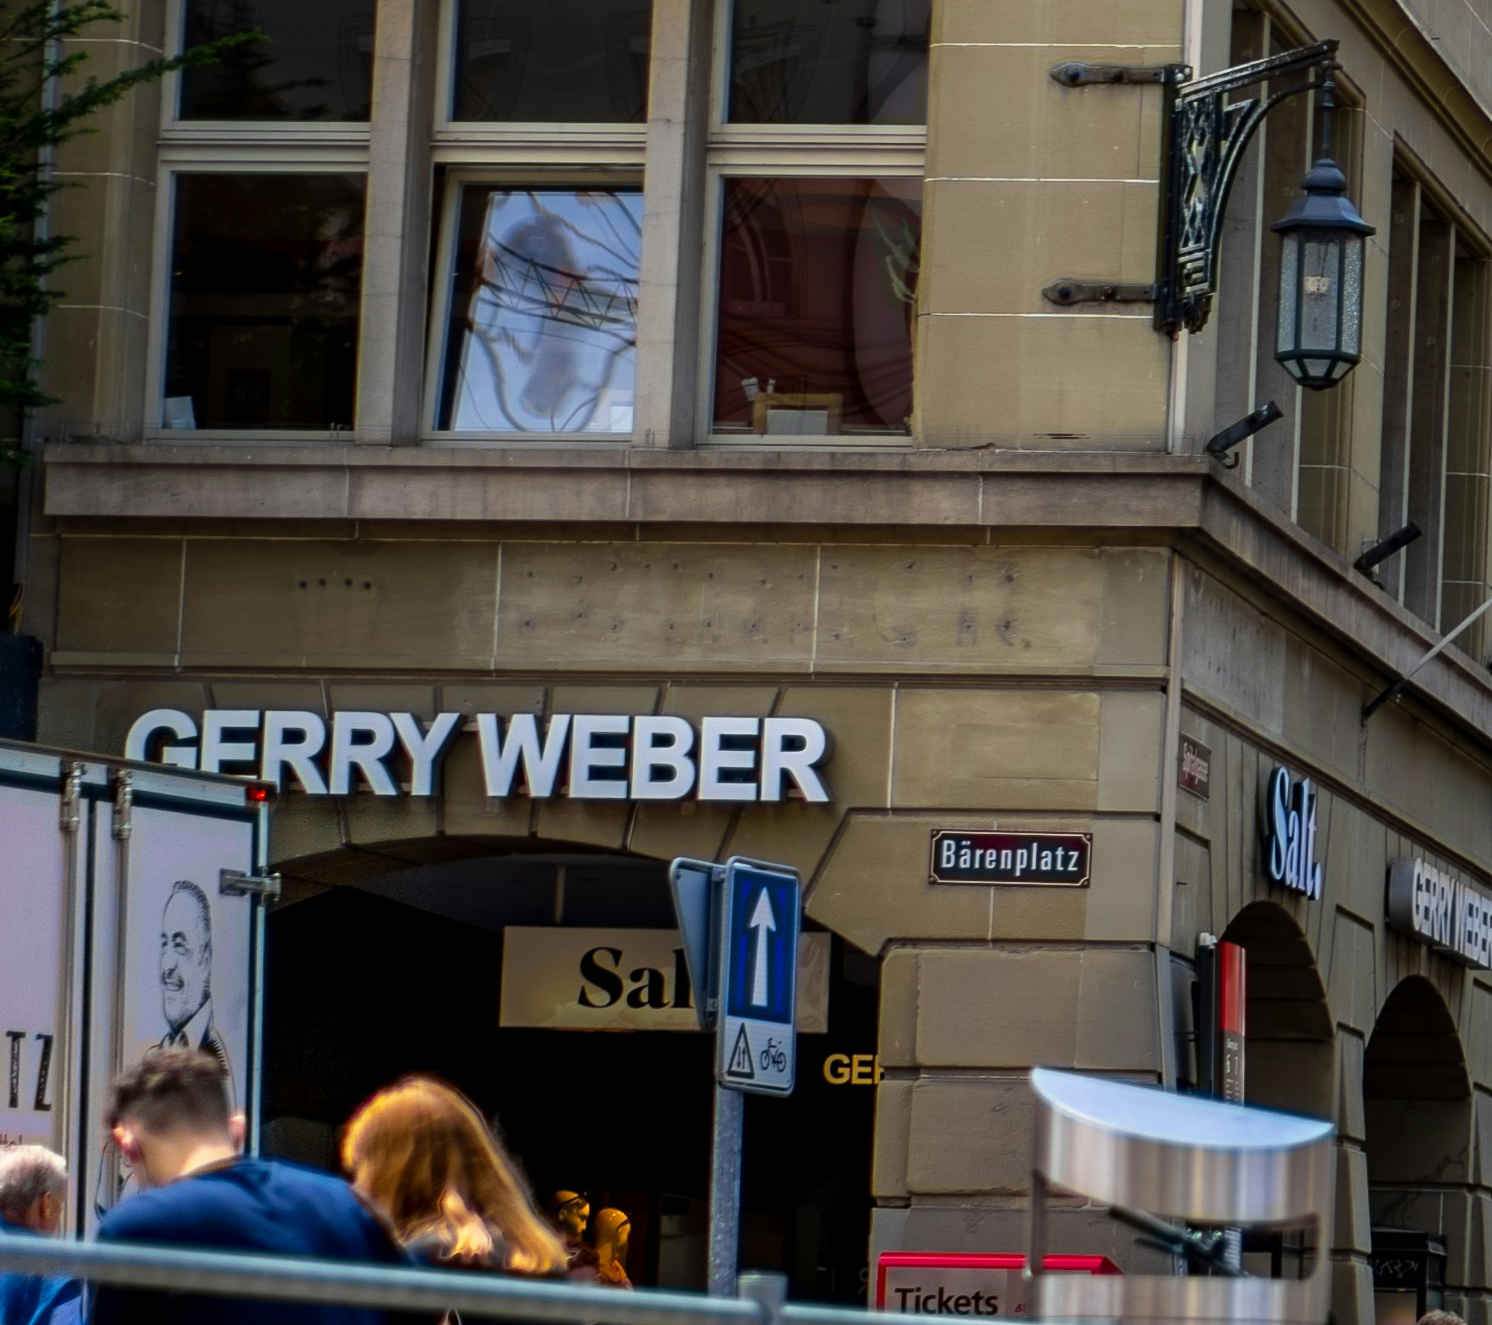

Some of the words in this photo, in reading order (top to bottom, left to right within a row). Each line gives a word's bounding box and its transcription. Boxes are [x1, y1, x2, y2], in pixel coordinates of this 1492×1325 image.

[124, 709, 464, 797] GERRY
[477, 713, 832, 803] WEBER
[940, 839, 1080, 877] Bärenplatz
[1412, 857, 1456, 947] GERRY
[577, 946, 696, 1010] Sal
[894, 1286, 999, 1316] Tickets
